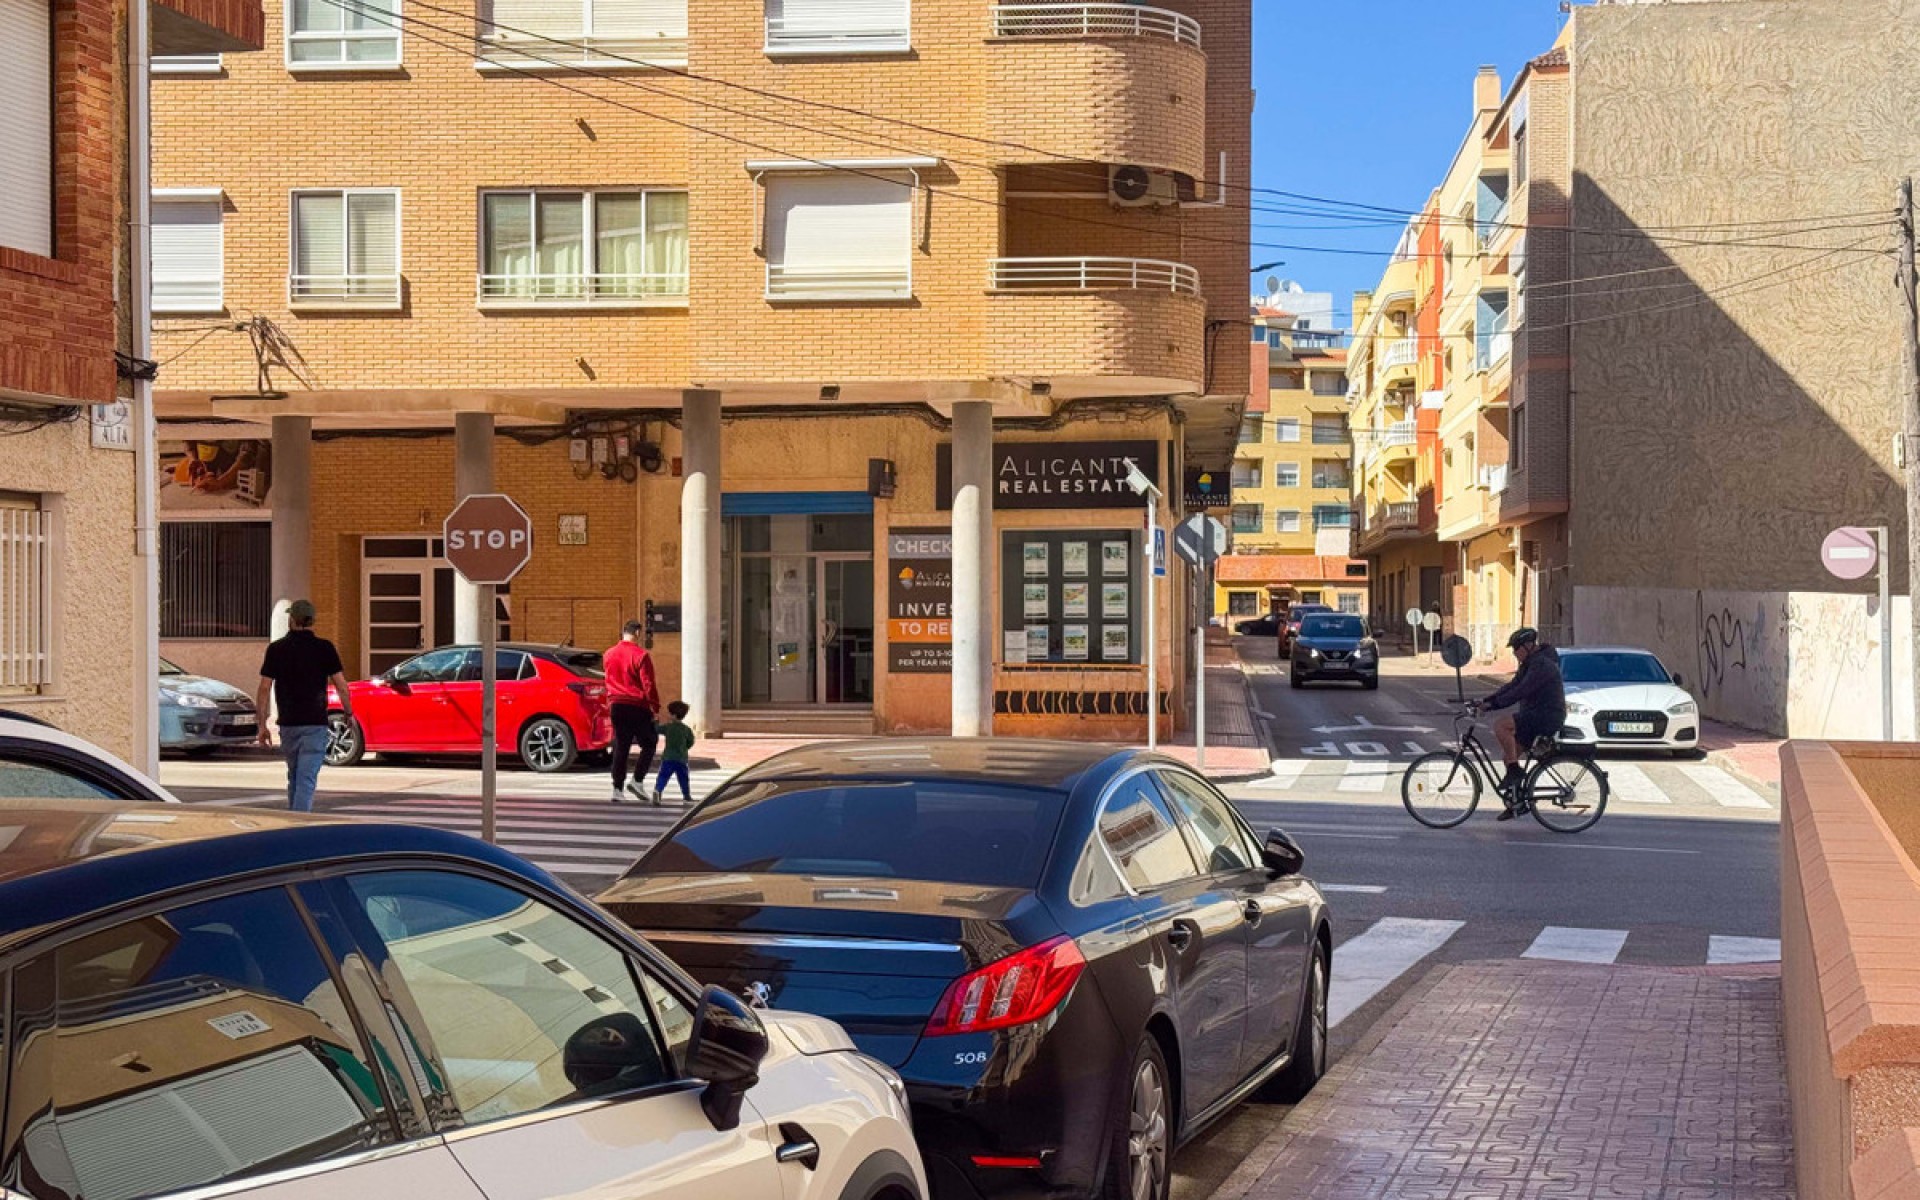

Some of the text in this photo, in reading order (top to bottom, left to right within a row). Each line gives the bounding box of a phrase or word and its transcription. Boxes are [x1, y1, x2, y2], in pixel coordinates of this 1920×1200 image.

[1000, 479, 1138, 494] REAL ESTAT
[449, 529, 526, 549] STOP
[895, 540, 952, 553] CHECK
[899, 602, 952, 616] INVE
[899, 622, 952, 635] TO RE
[953, 1050, 987, 1065] 508
